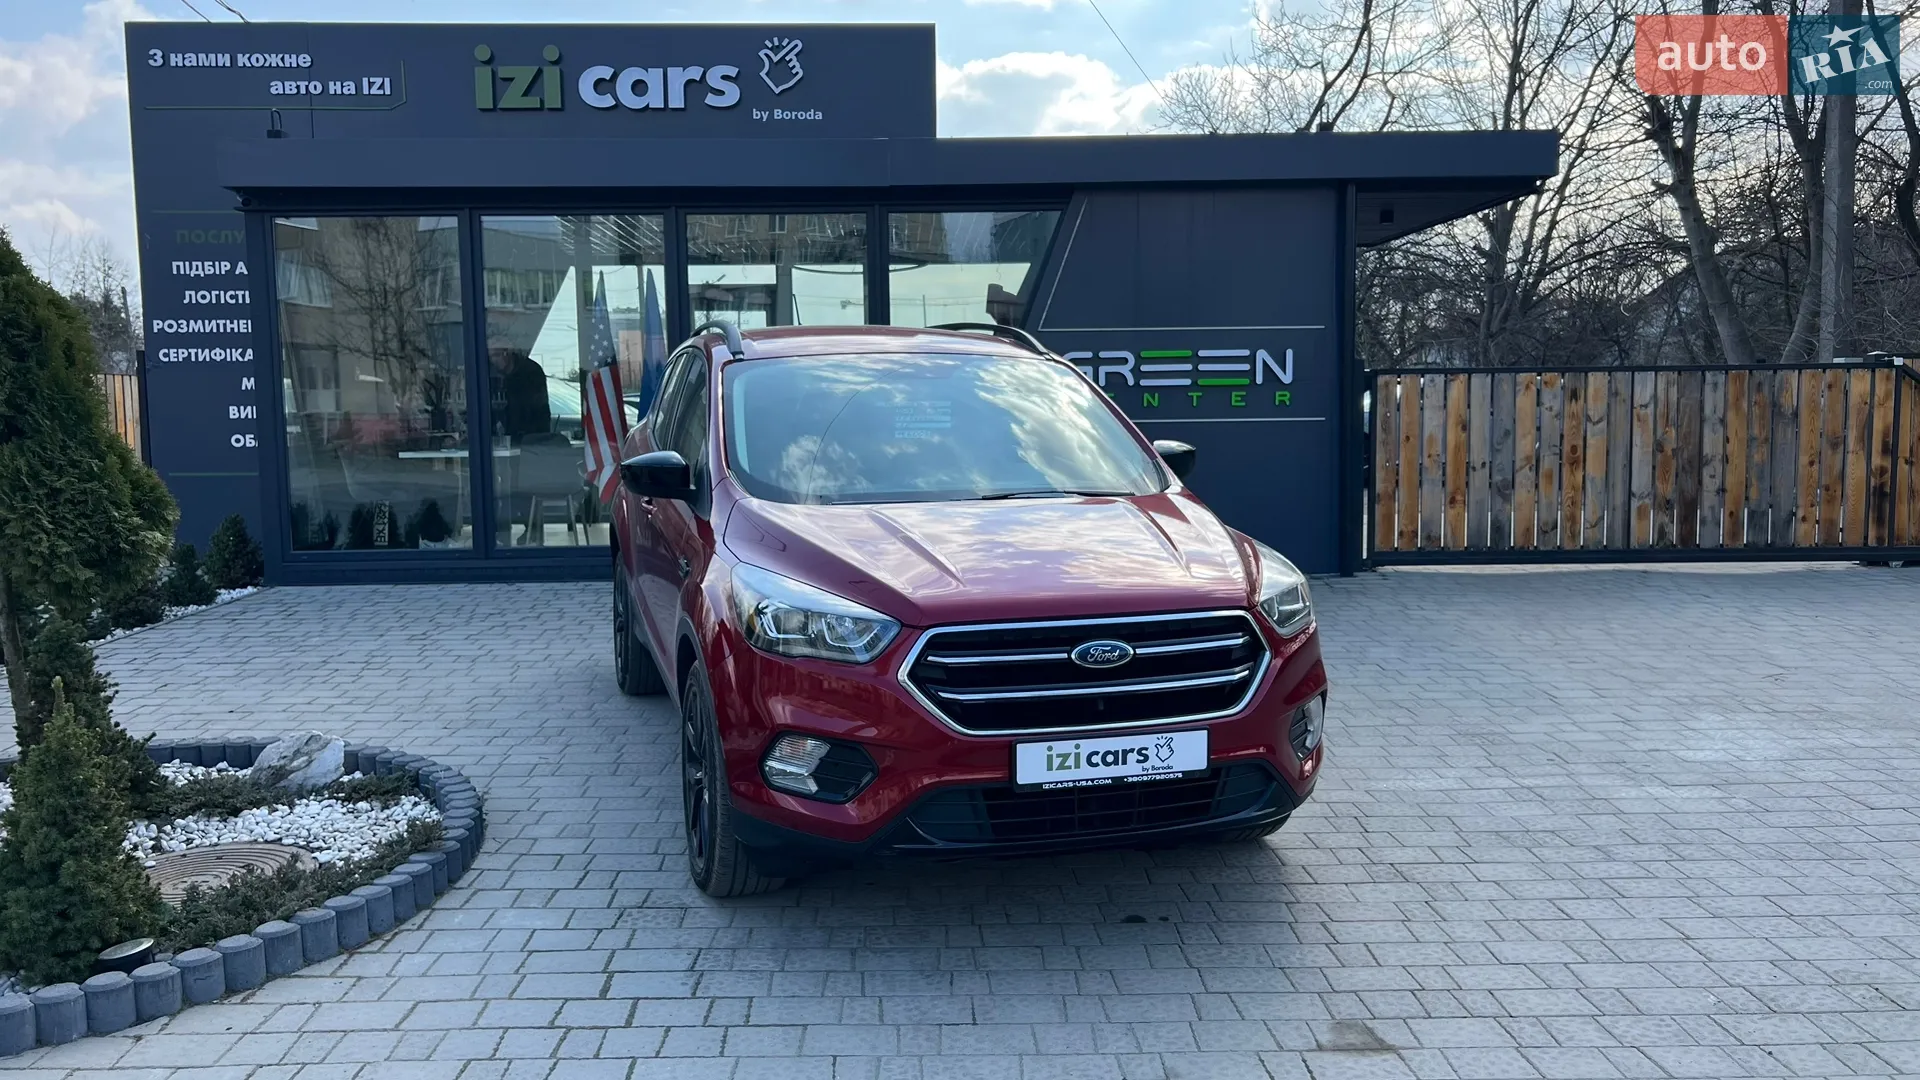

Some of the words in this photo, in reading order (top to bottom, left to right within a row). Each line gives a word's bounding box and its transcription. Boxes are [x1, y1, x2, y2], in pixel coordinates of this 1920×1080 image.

[170, 53, 231, 67] нами
[237, 53, 312, 68] кожне
[474, 44, 564, 110] izi
[578, 65, 741, 109] cars
[270, 80, 323, 95] авто
[329, 80, 356, 95] на
[362, 77, 391, 95] IZI
[752, 108, 769, 121] by
[773, 109, 823, 121] Boroda
[171, 261, 231, 277] ПІДБІР
[183, 290, 250, 304] ЛОГІСТ
[153, 319, 252, 333] РОЗМИТНЕ
[158, 348, 253, 362] СЕРТИФІКА
[230, 434, 258, 448] ОБ
[1087, 646, 1119, 662] Ford
[1046, 743, 1081, 772] izi
[1086, 746, 1149, 768] cars
[1042, 778, 1112, 789] IZICARS-USA.COM
